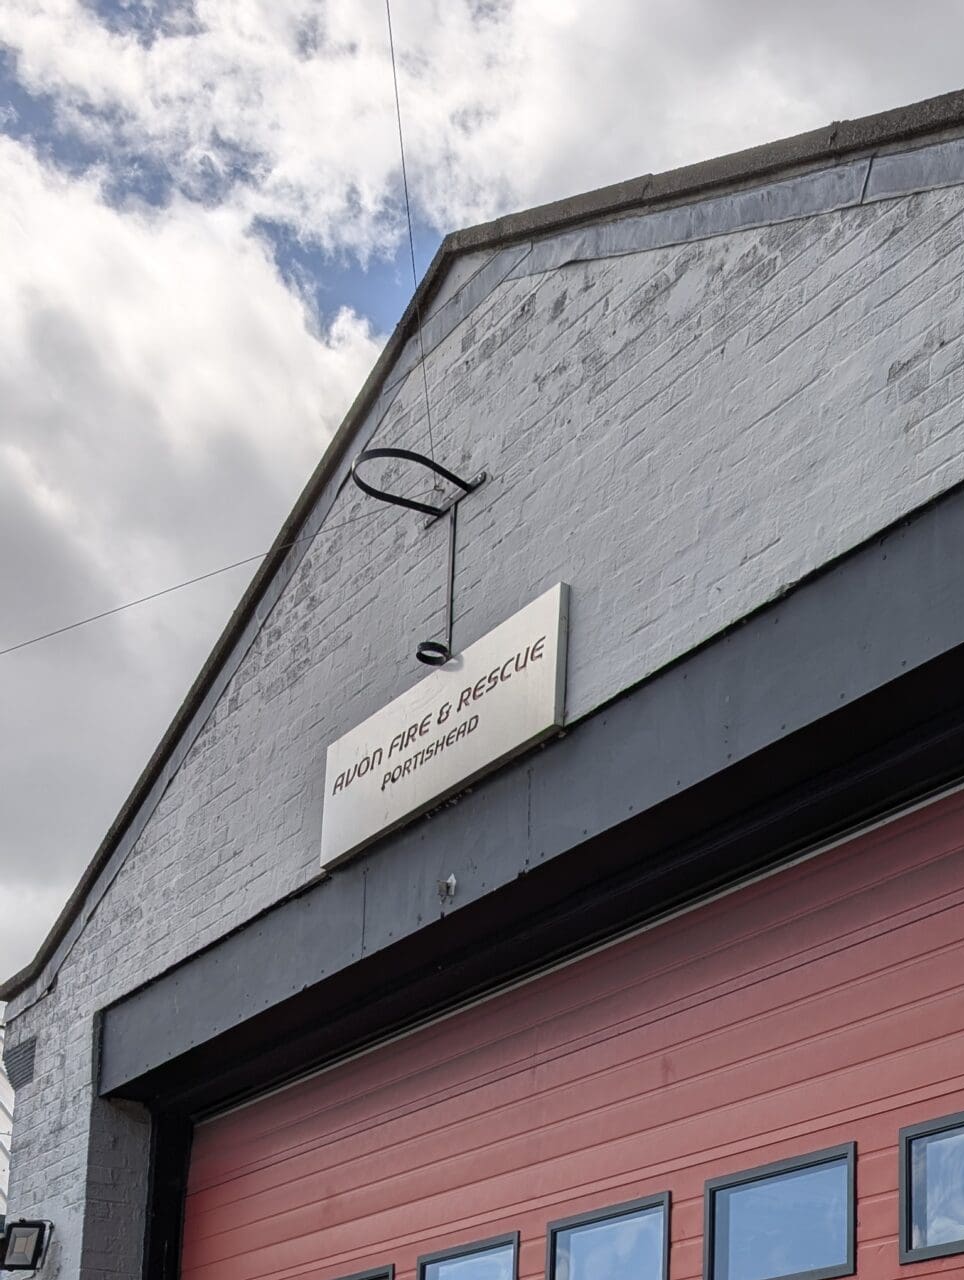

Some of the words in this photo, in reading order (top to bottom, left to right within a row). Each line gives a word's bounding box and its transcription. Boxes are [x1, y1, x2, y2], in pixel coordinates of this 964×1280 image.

[332, 747, 383, 797] AVON
[388, 712, 433, 759] FIRE
[437, 701, 453, 725] &
[457, 635, 547, 713] RESCUE
[381, 714, 479, 792] PORTISHEAD
